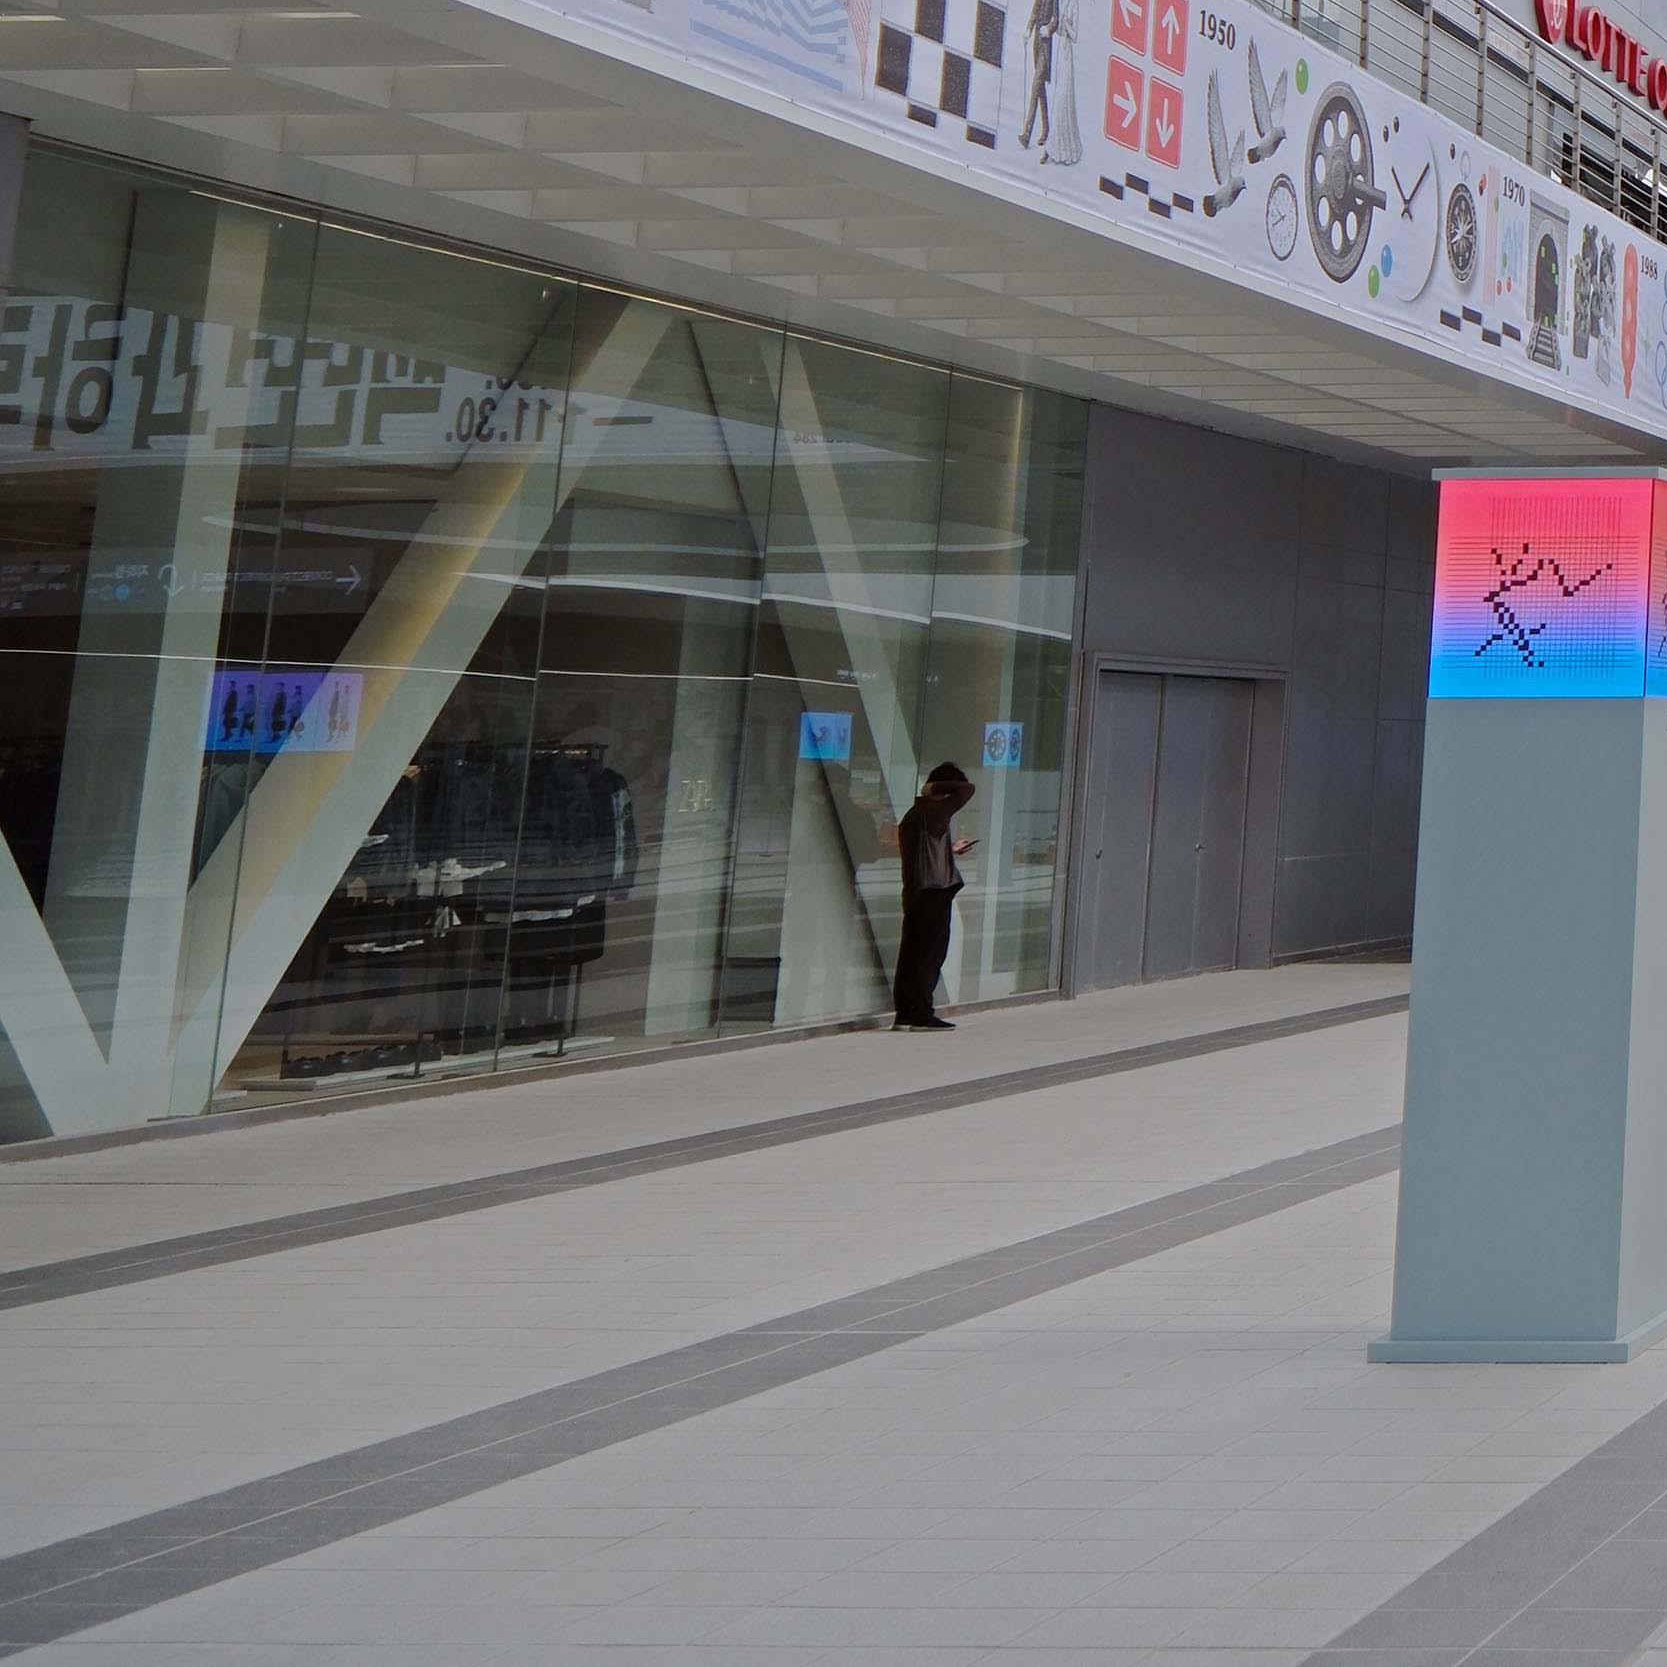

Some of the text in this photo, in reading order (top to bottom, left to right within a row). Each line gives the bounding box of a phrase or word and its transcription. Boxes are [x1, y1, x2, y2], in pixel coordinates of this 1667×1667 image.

[1198, 9, 1236, 51] 1950
[1503, 176, 1525, 207] 1970
[1641, 255, 1658, 281] 1988
